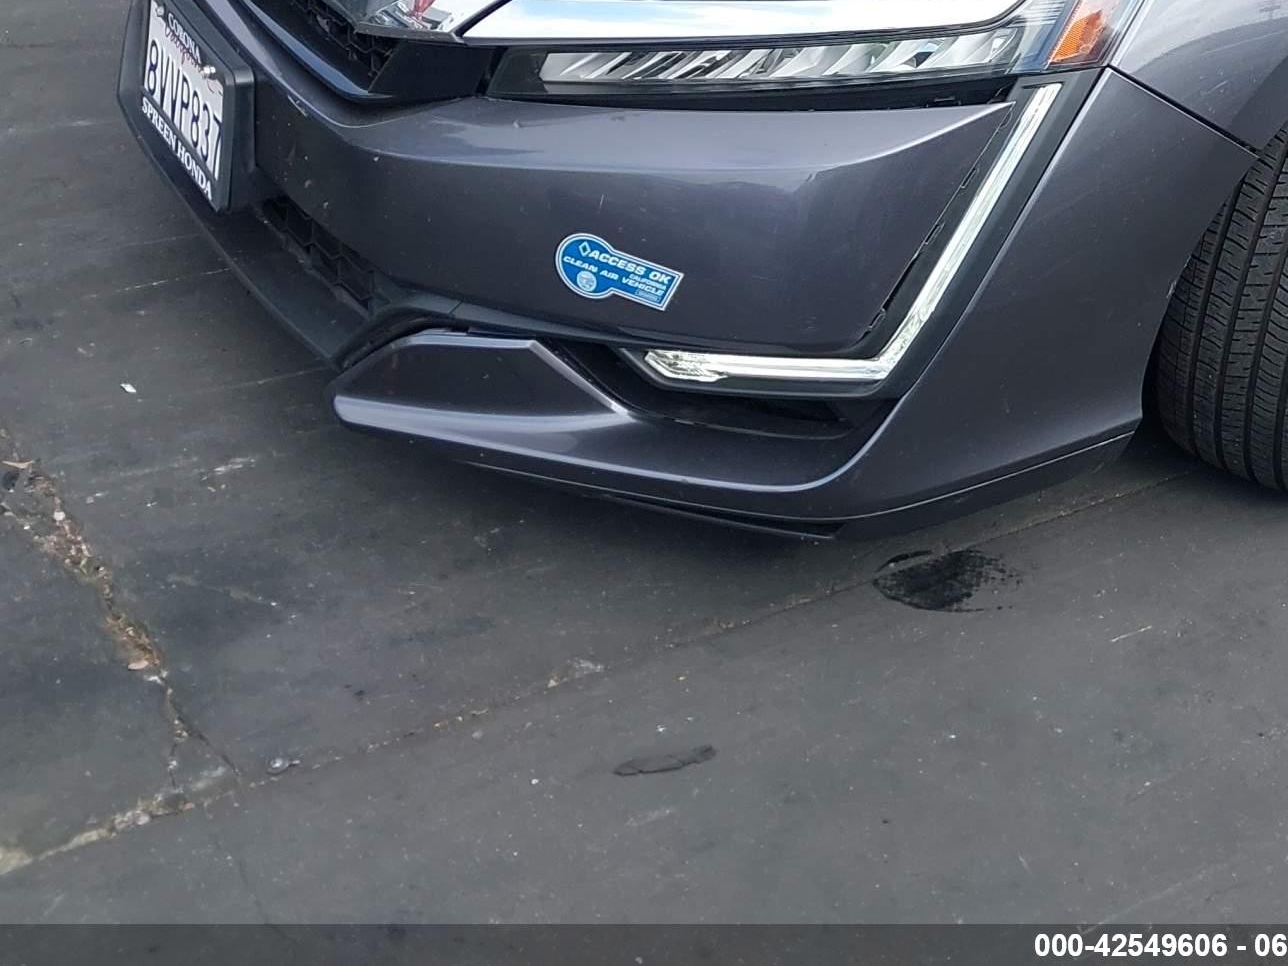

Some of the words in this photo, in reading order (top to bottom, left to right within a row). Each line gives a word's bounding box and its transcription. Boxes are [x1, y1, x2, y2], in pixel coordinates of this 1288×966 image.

[167, 11, 201, 60] CORONA
[147, 39, 223, 180] 8VVP837
[142, 96, 177, 152] SPREEN
[176, 143, 213, 201] HONDA
[563, 255, 598, 273] CLEAN
[599, 269, 619, 281] AIR
[622, 276, 665, 296] VEHICLE
[589, 249, 646, 276] ACCESS
[648, 271, 672, 285] OK
